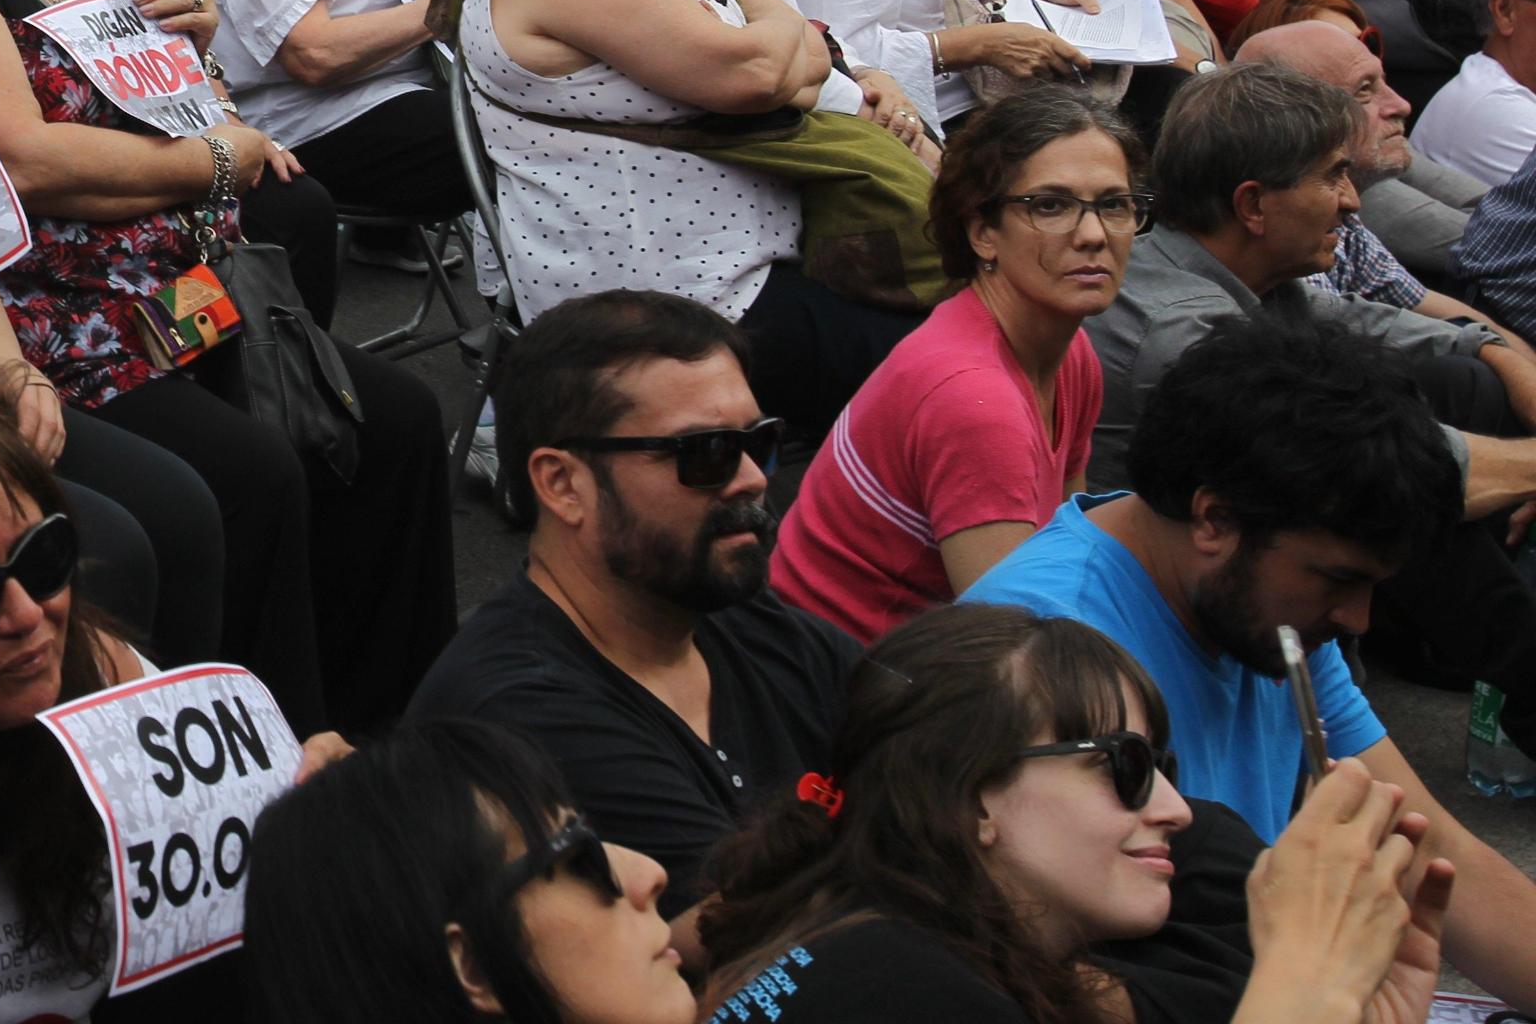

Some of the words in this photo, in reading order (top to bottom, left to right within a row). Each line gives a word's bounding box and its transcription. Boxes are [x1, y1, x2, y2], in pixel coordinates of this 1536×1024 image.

[79, 5, 148, 42] DIGAN
[92, 36, 205, 101] DÓNDE
[137, 696, 273, 798] SON
[0, 950, 24, 972] DE
